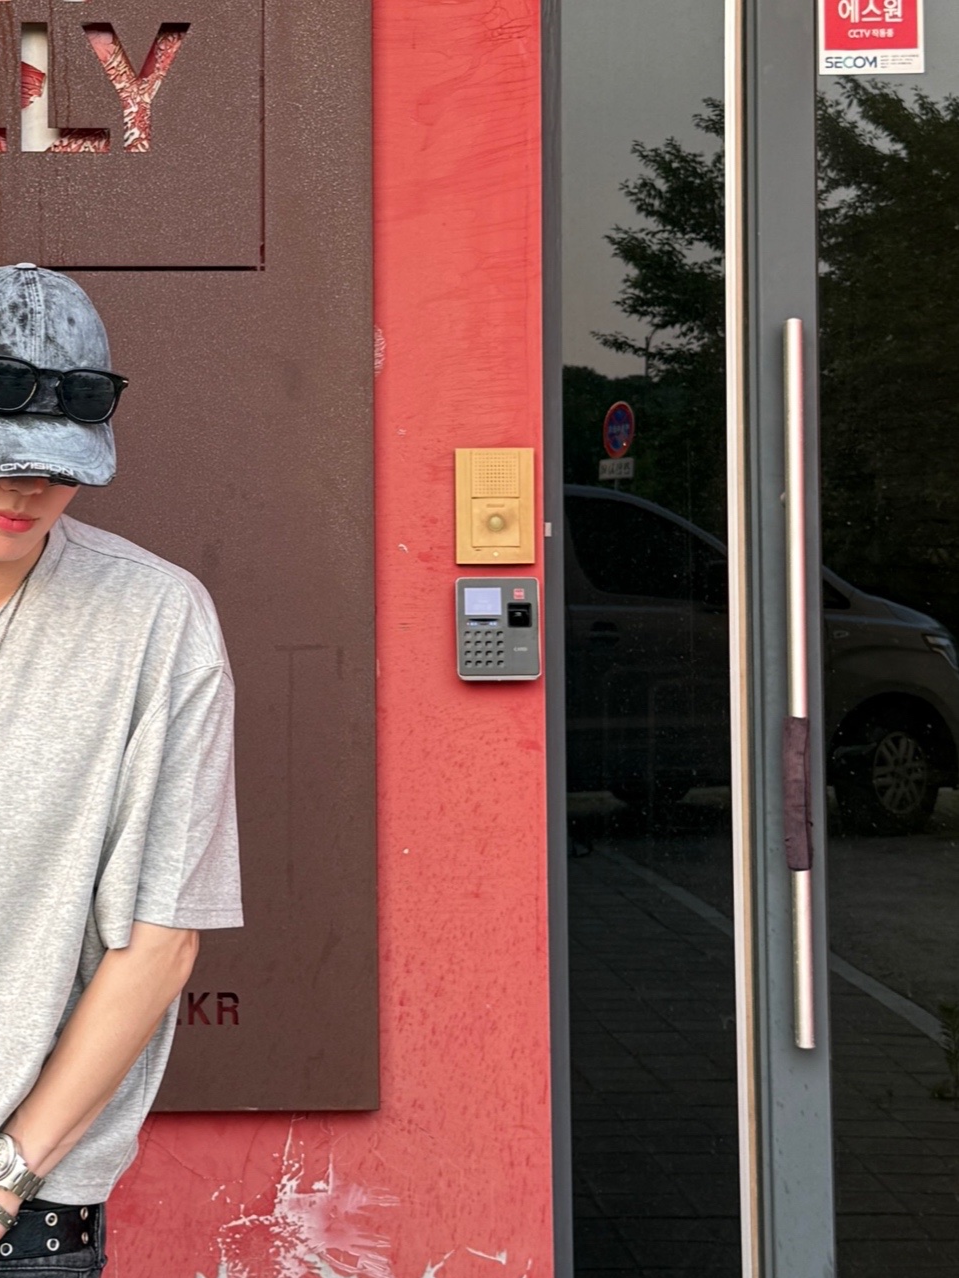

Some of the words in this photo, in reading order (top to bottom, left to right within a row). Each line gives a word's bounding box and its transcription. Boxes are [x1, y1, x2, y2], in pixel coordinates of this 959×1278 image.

[838, 0, 903, 23] 에스원
[848, 28, 871, 38] CCTV
[825, 56, 877, 68] SECOM
